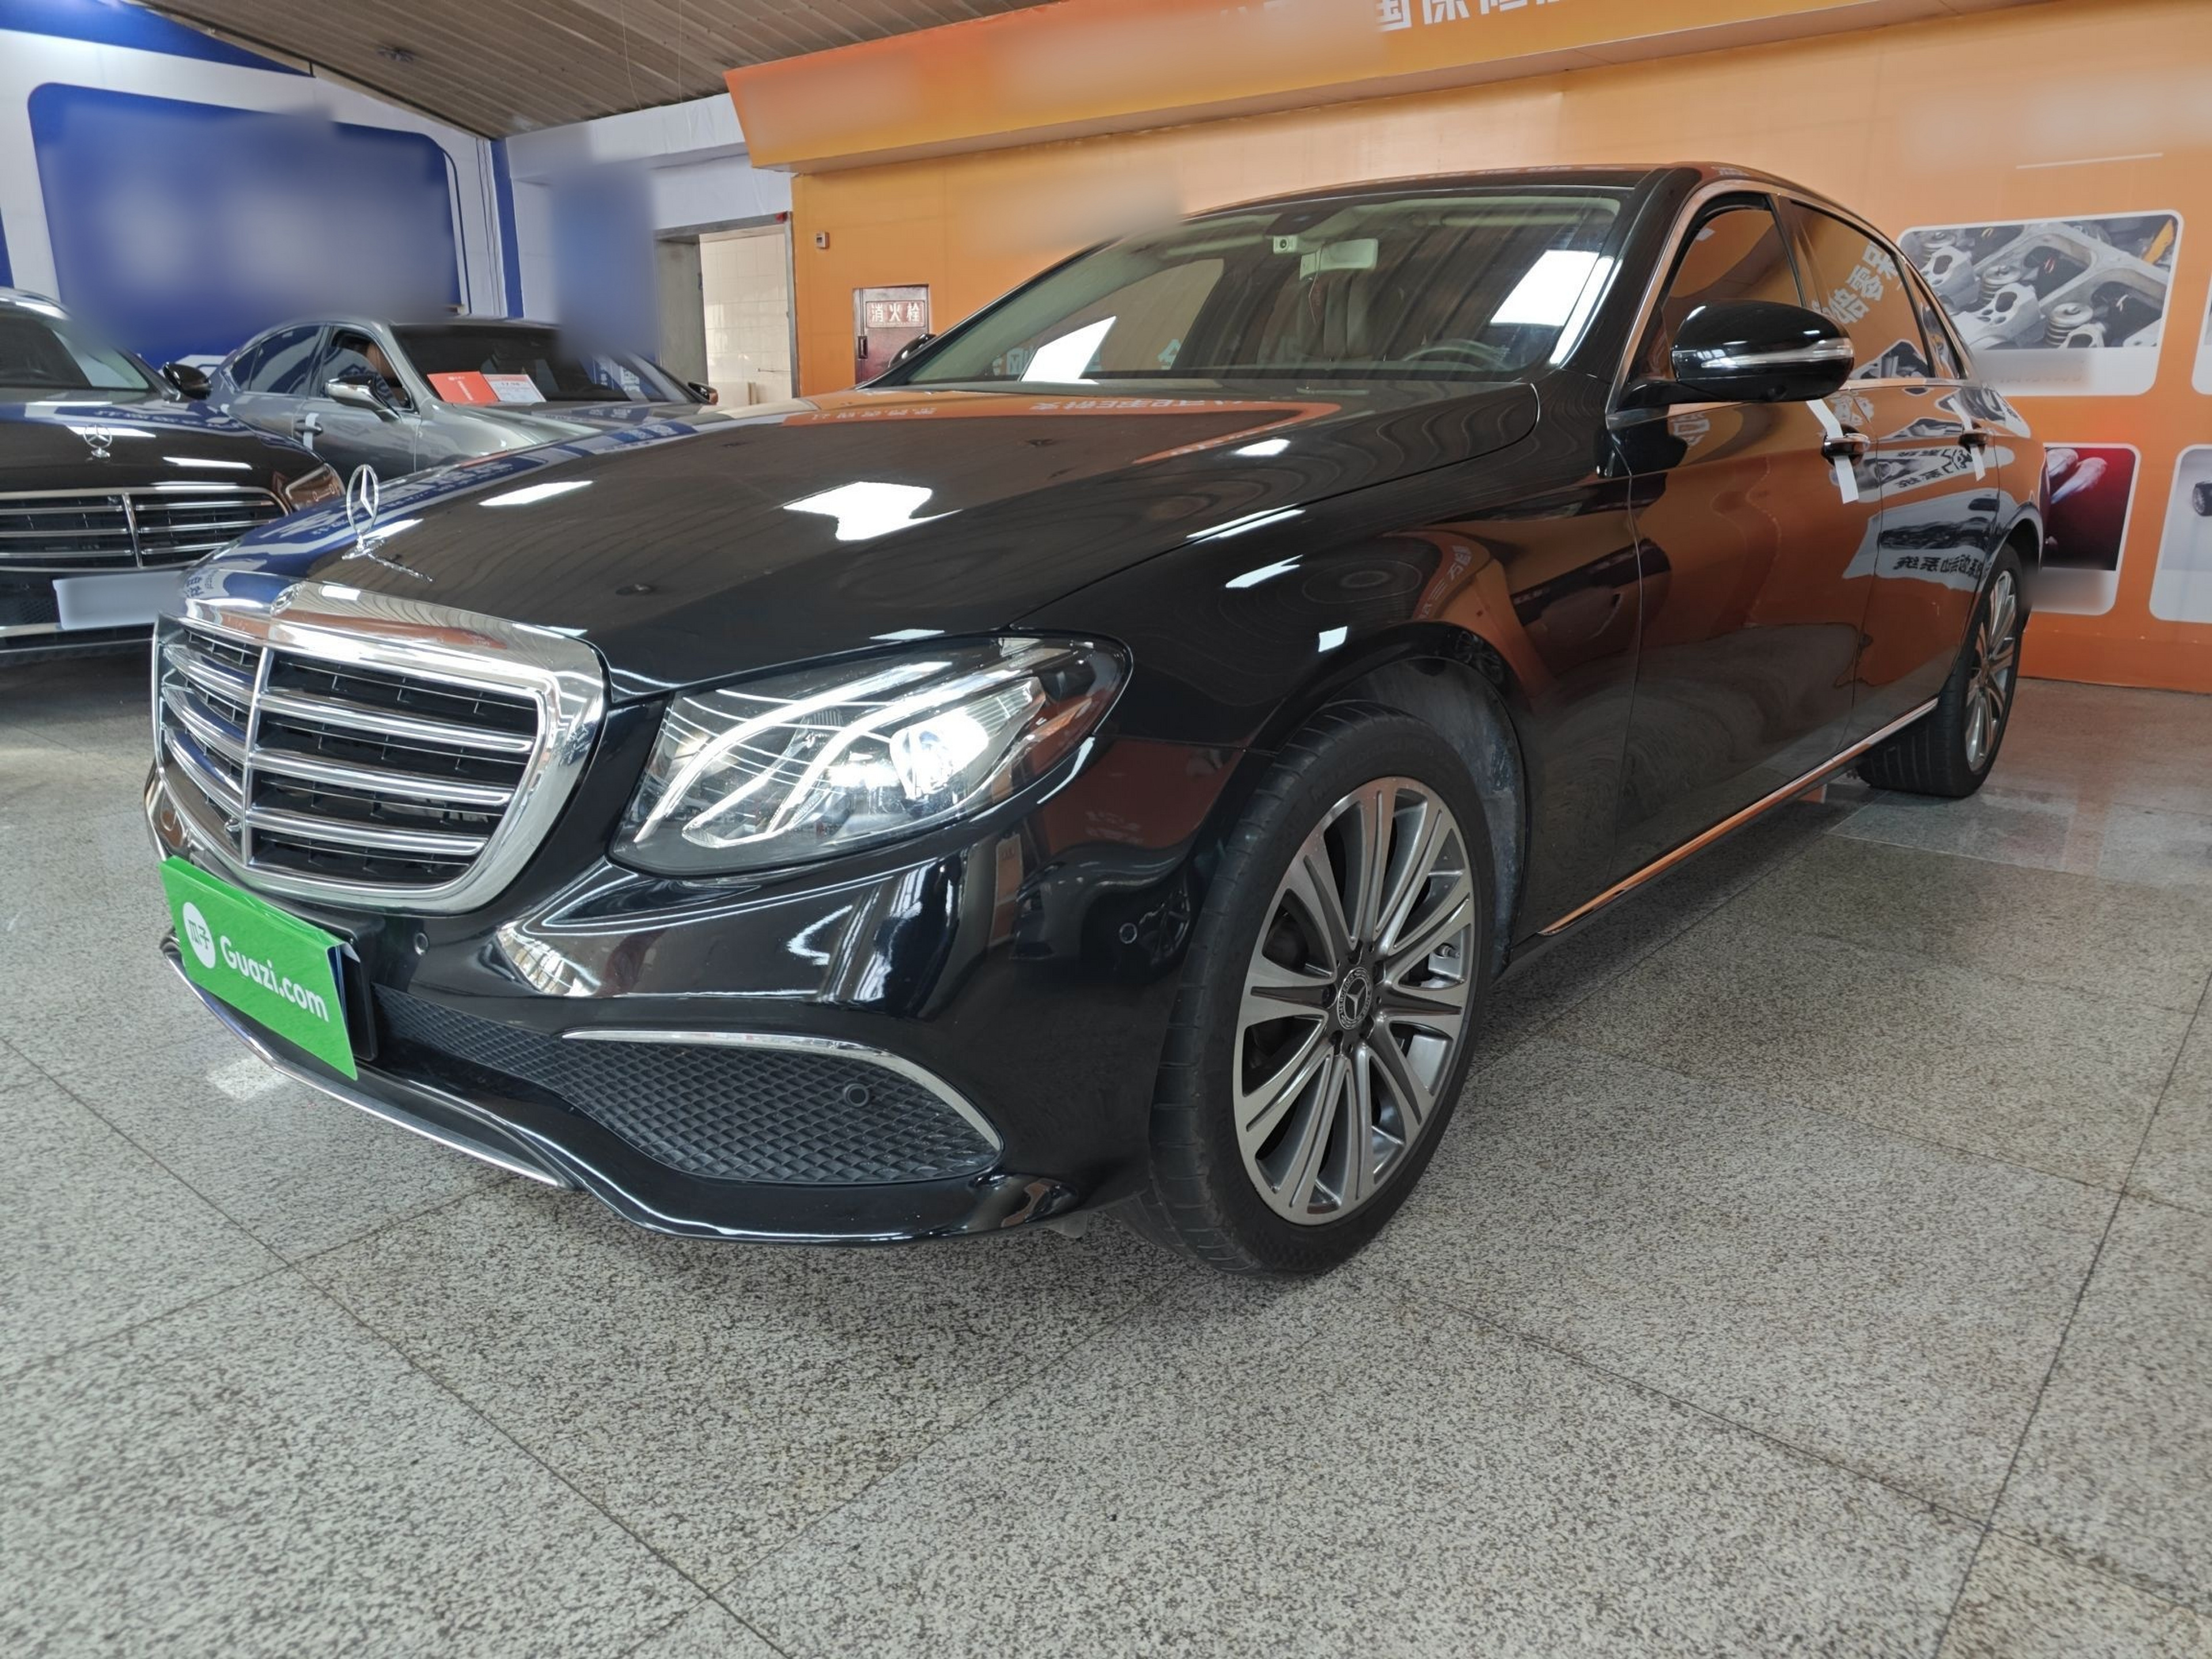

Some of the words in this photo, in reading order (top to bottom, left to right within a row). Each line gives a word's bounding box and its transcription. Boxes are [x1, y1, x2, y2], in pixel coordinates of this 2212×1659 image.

[870, 302, 920, 323] 消火栓
[188, 919, 209, 950] 瓜子
[220, 935, 329, 1022] Guazi.com
